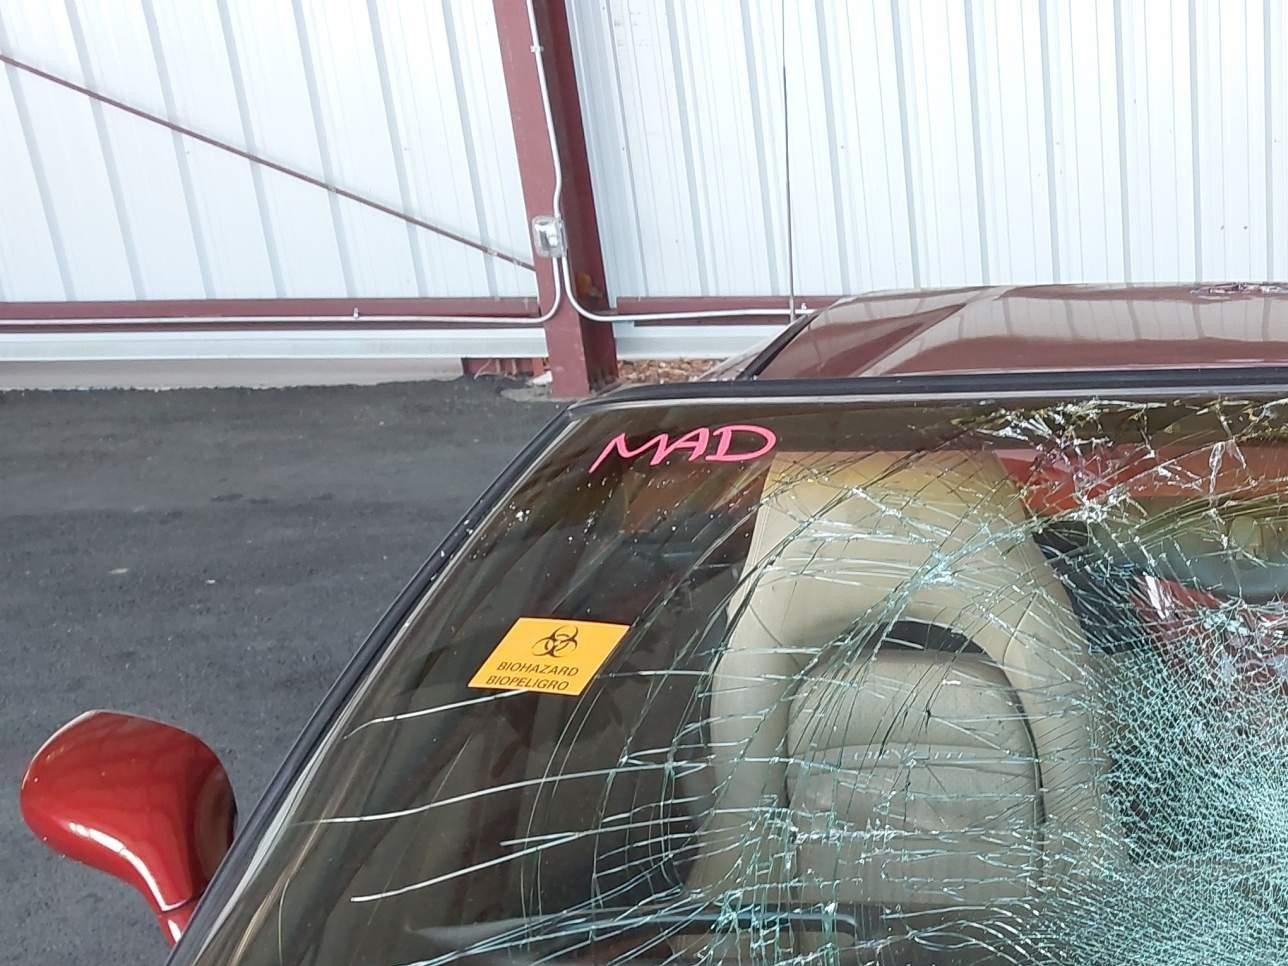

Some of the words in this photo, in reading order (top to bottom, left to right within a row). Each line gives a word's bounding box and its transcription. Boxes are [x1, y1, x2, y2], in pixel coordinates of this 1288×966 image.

[588, 424, 777, 474] MAD
[497, 661, 579, 677] BIOHAZARD
[486, 675, 570, 691] BIOPELIGRO
